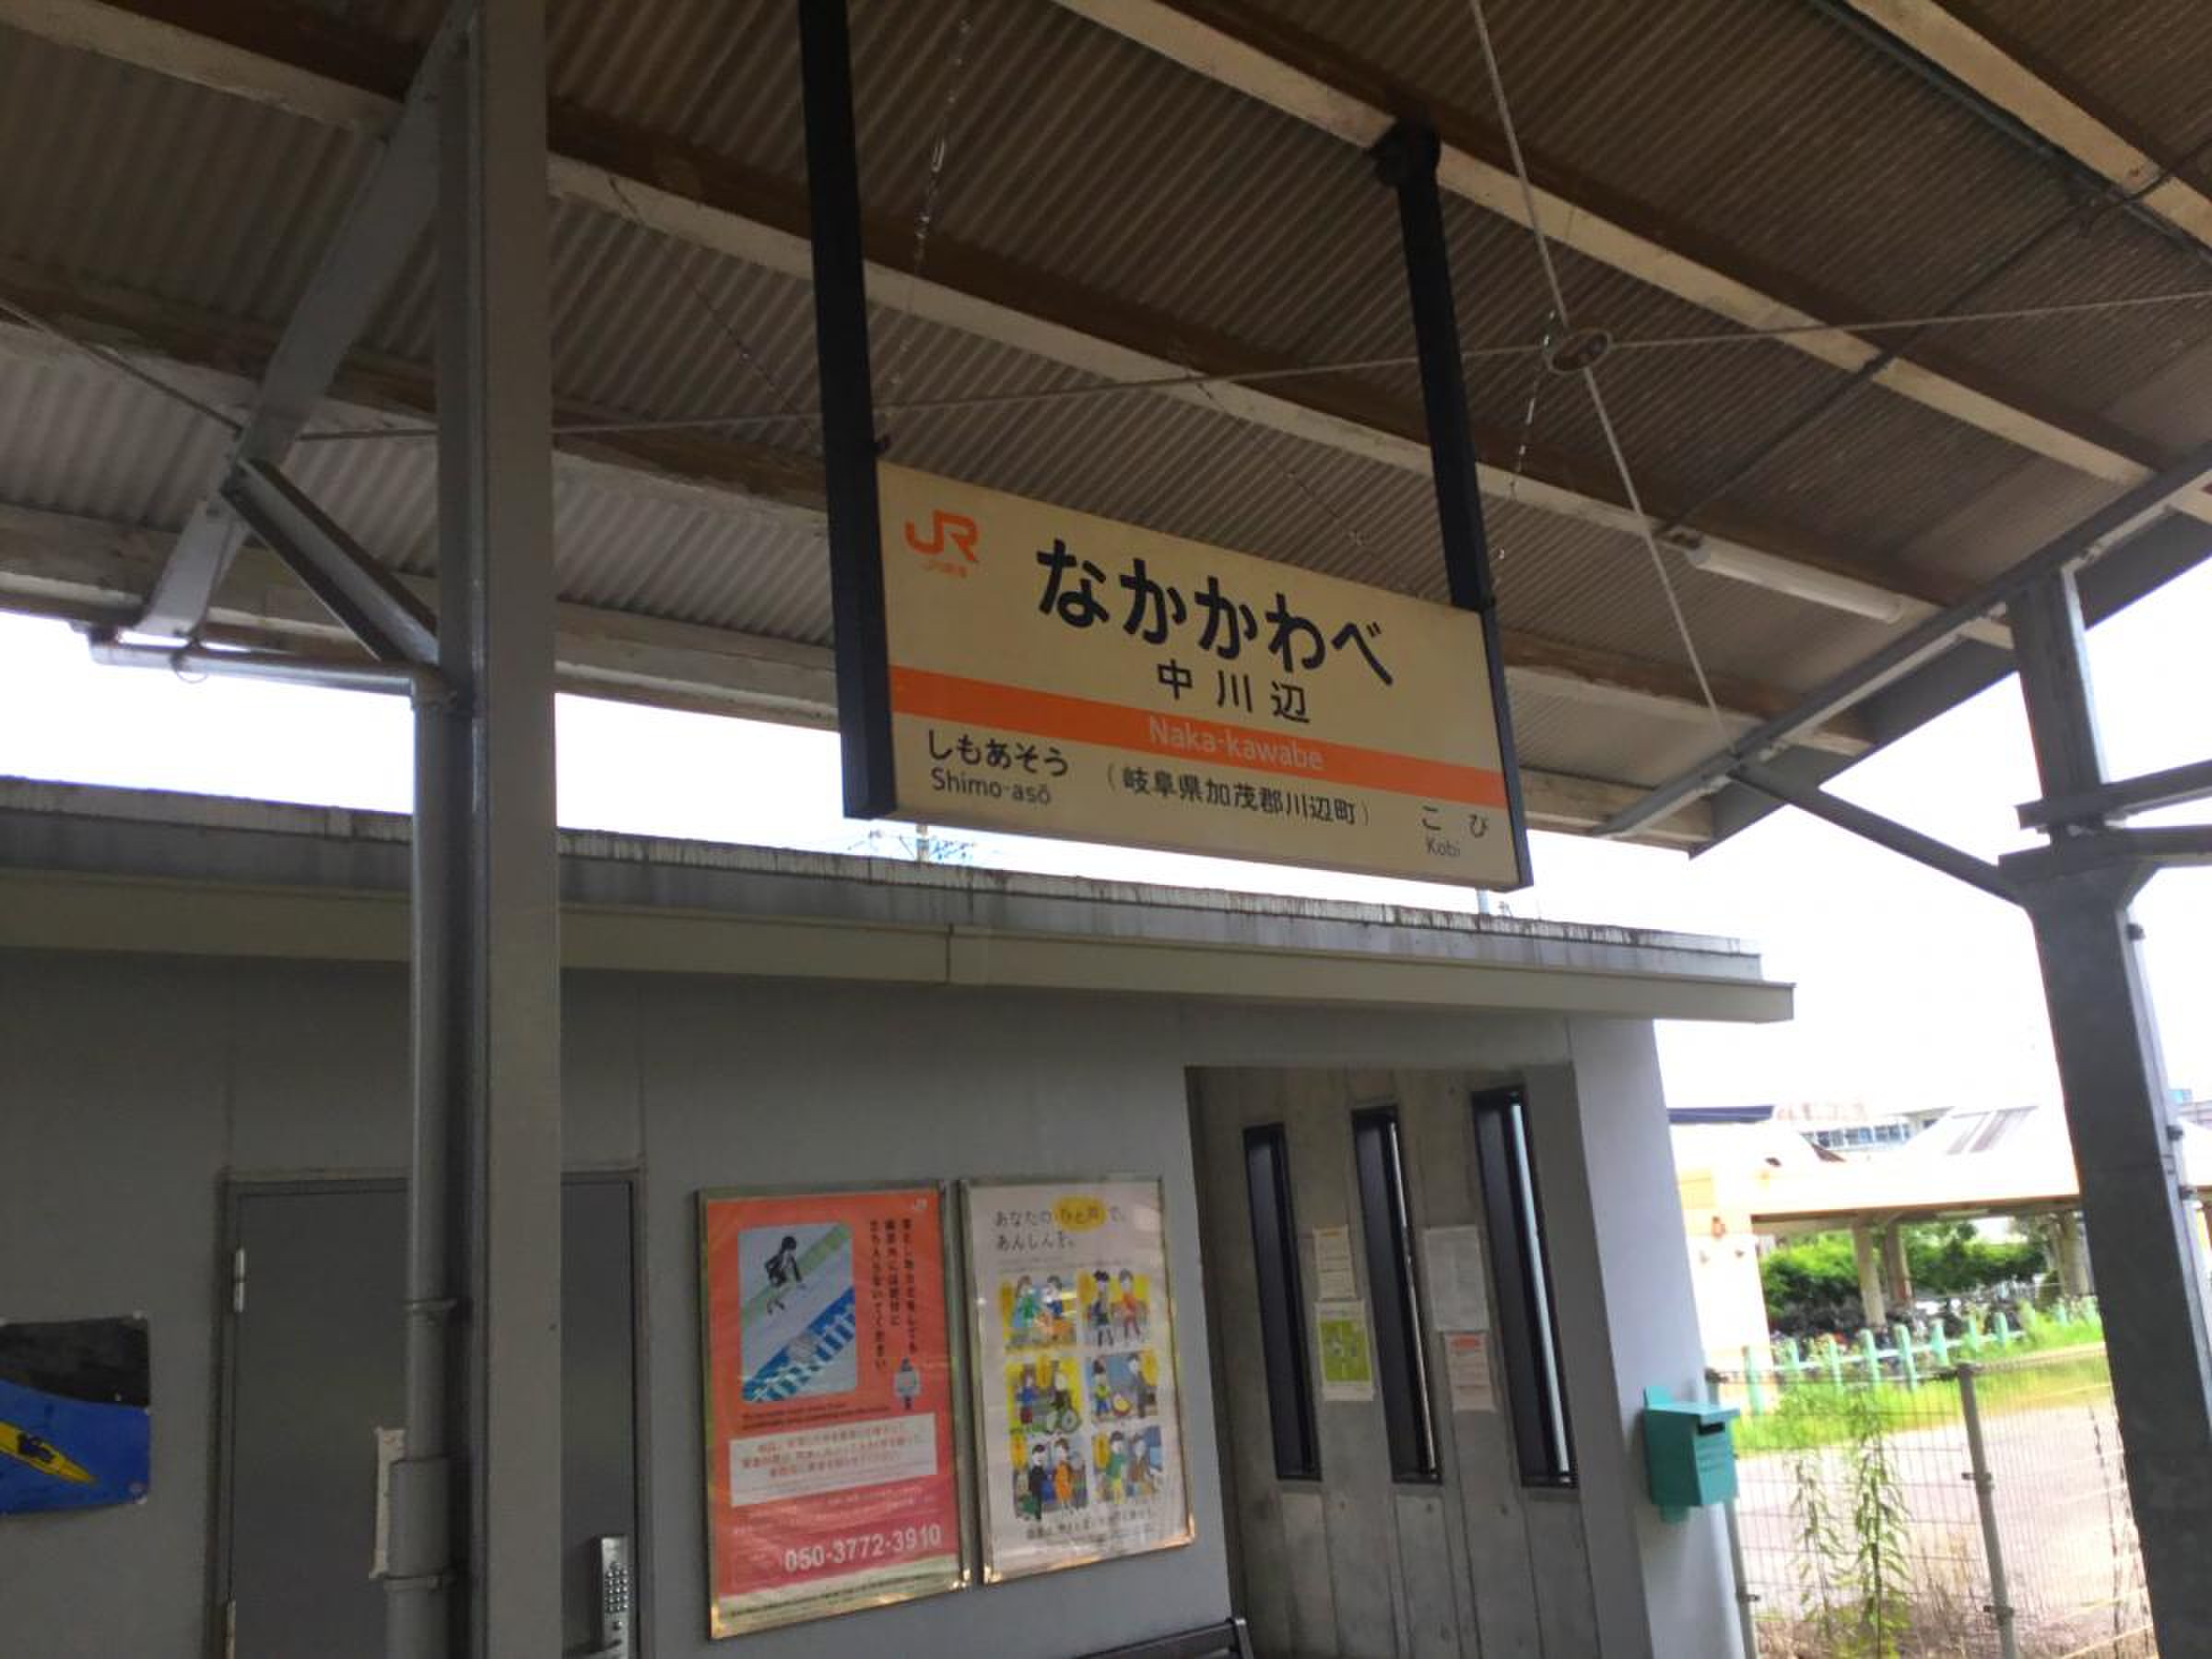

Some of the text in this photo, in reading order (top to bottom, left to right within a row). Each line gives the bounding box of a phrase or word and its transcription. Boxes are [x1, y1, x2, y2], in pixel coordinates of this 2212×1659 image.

[904, 509, 979, 561] JR
[1036, 538, 1393, 686] なかかわべ
[1157, 658, 1311, 724] 中川辺
[927, 729, 1069, 777] しもあそう
[1149, 715, 1324, 771] Naka-kawabe
[784, 1523, 942, 1573] 050-3772-3910
